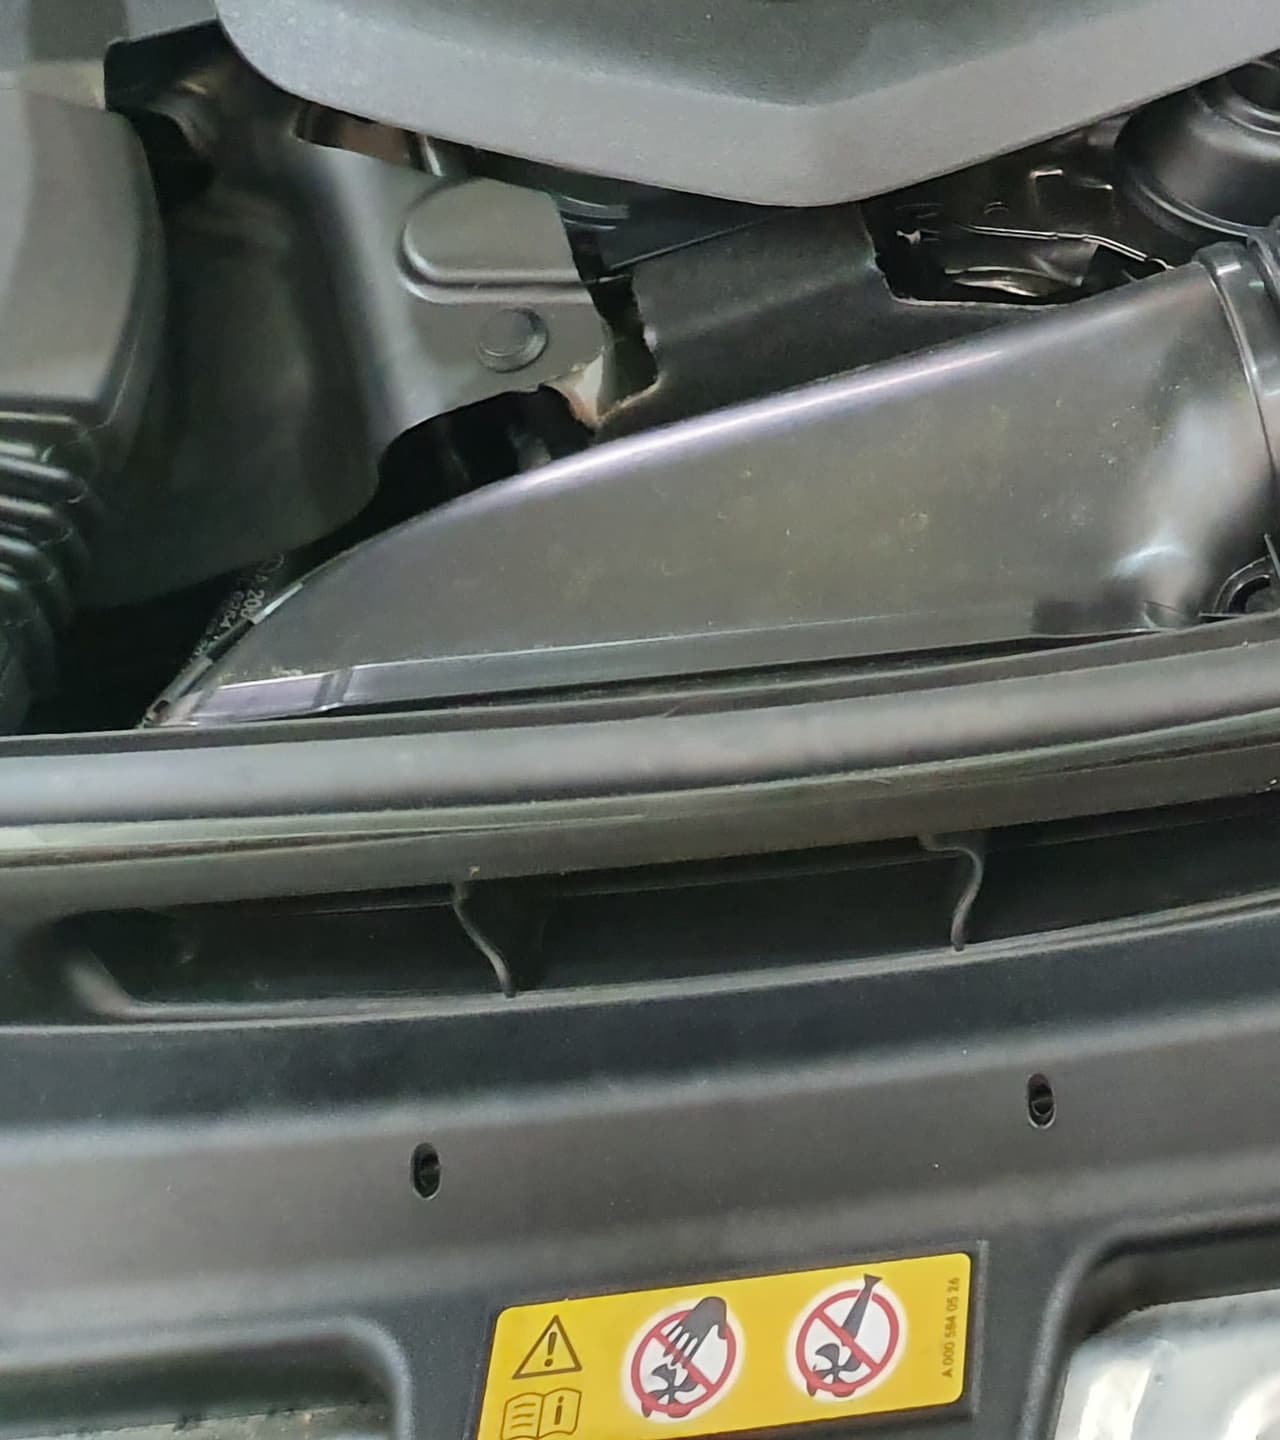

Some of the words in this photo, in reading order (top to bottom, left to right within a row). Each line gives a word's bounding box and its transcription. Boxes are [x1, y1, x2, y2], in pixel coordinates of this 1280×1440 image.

[947, 1277, 960, 1293] 26
[945, 1296, 959, 1312] 05
[941, 1341, 956, 1366] 000
